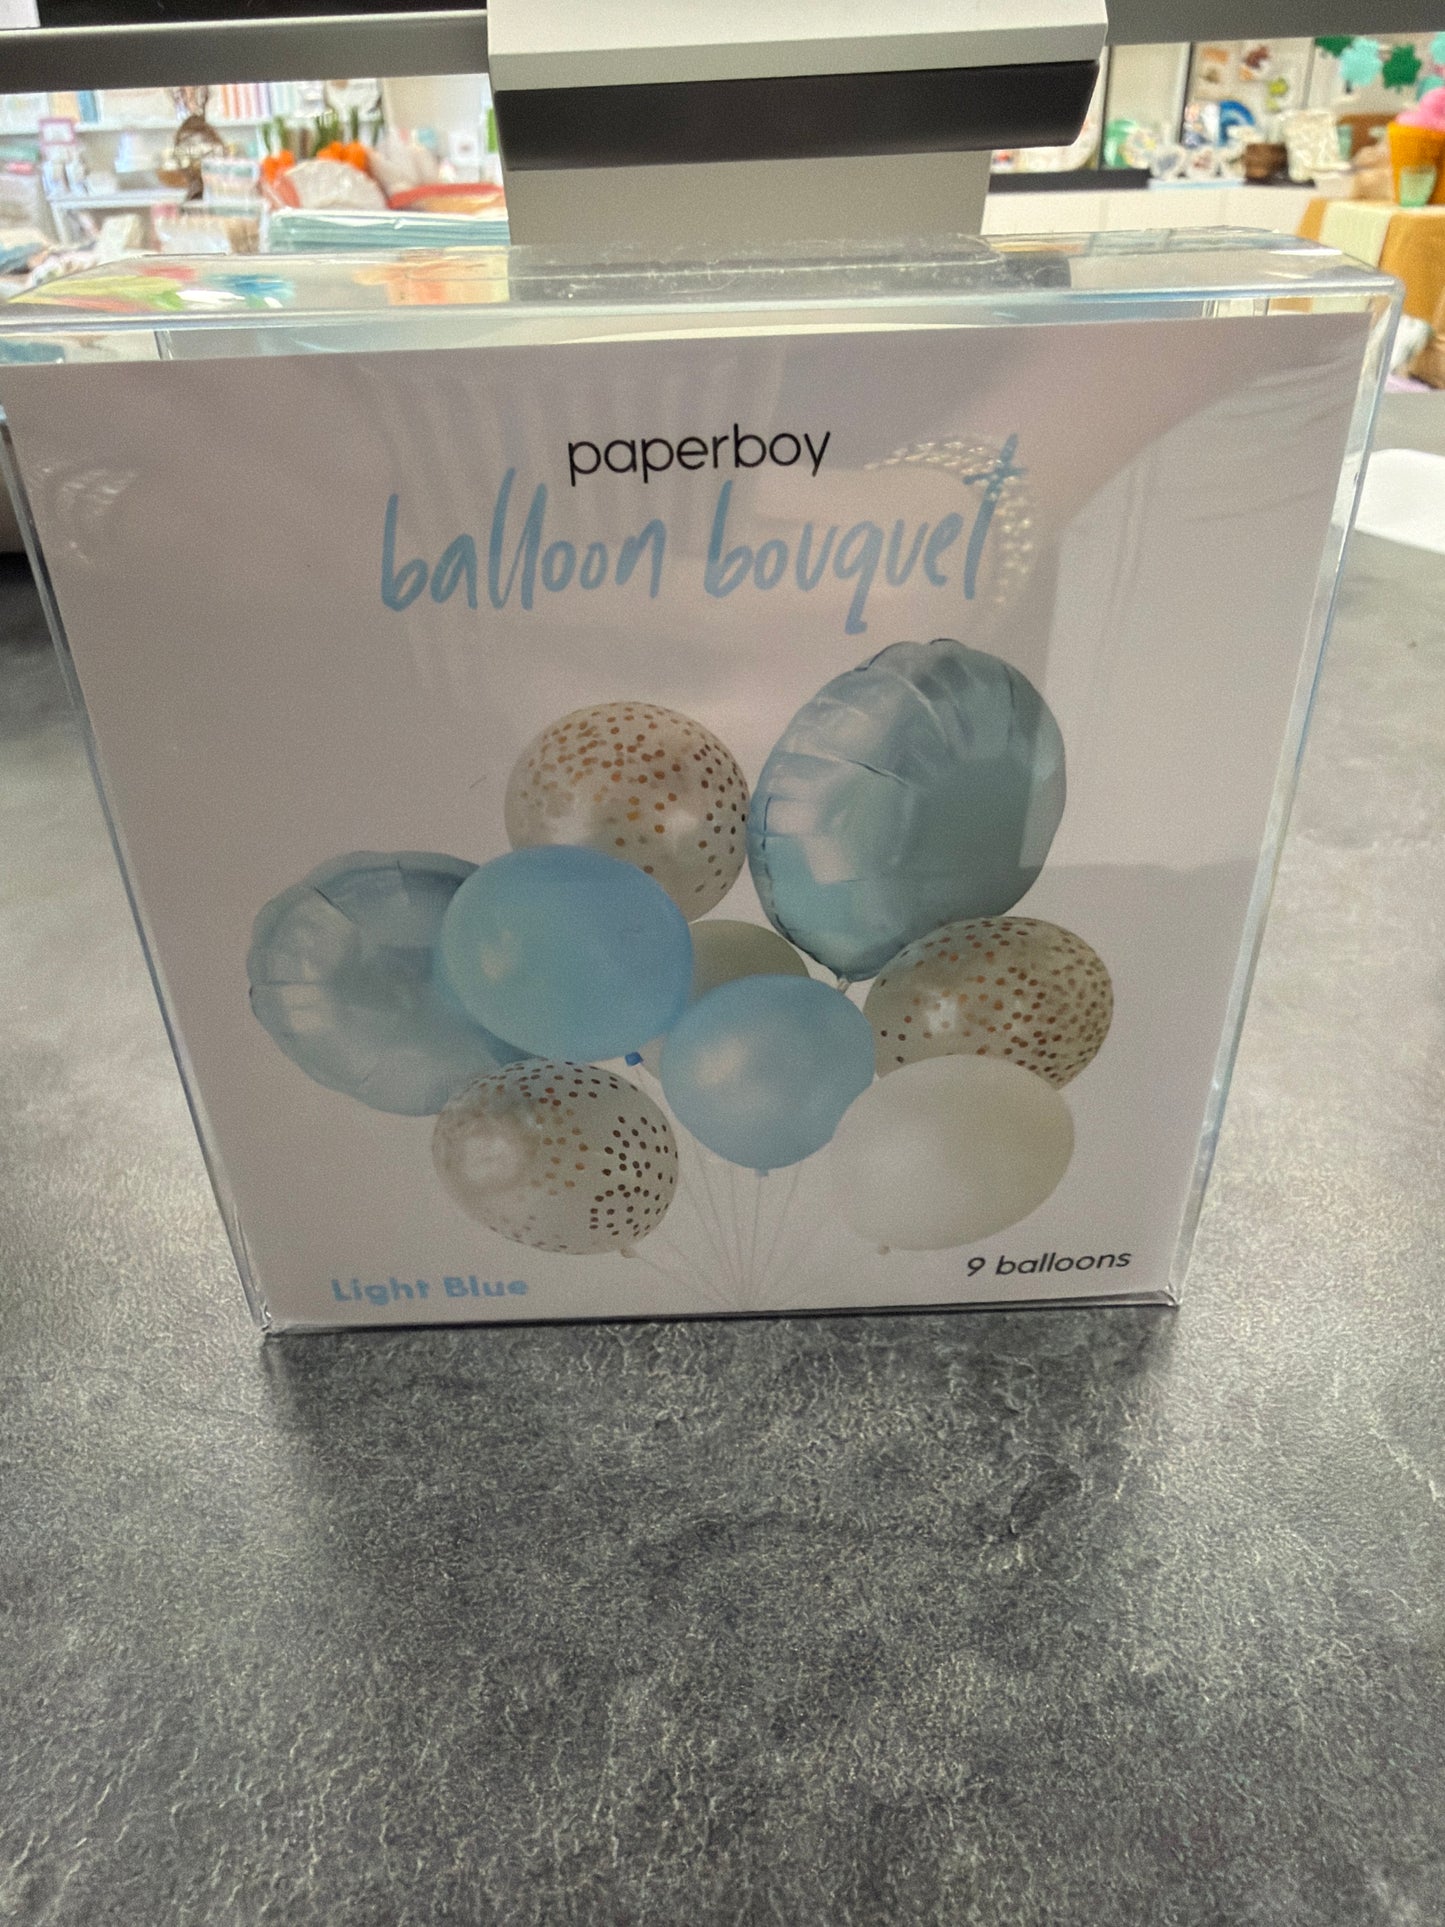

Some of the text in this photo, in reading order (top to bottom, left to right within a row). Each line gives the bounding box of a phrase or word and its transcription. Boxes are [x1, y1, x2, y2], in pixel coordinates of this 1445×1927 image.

[568, 423, 831, 487] paperboy
[381, 433, 1027, 635] balloon bouquet
[967, 1252, 1132, 1277] 9 balloons
[331, 1275, 528, 1306] Light Blue
